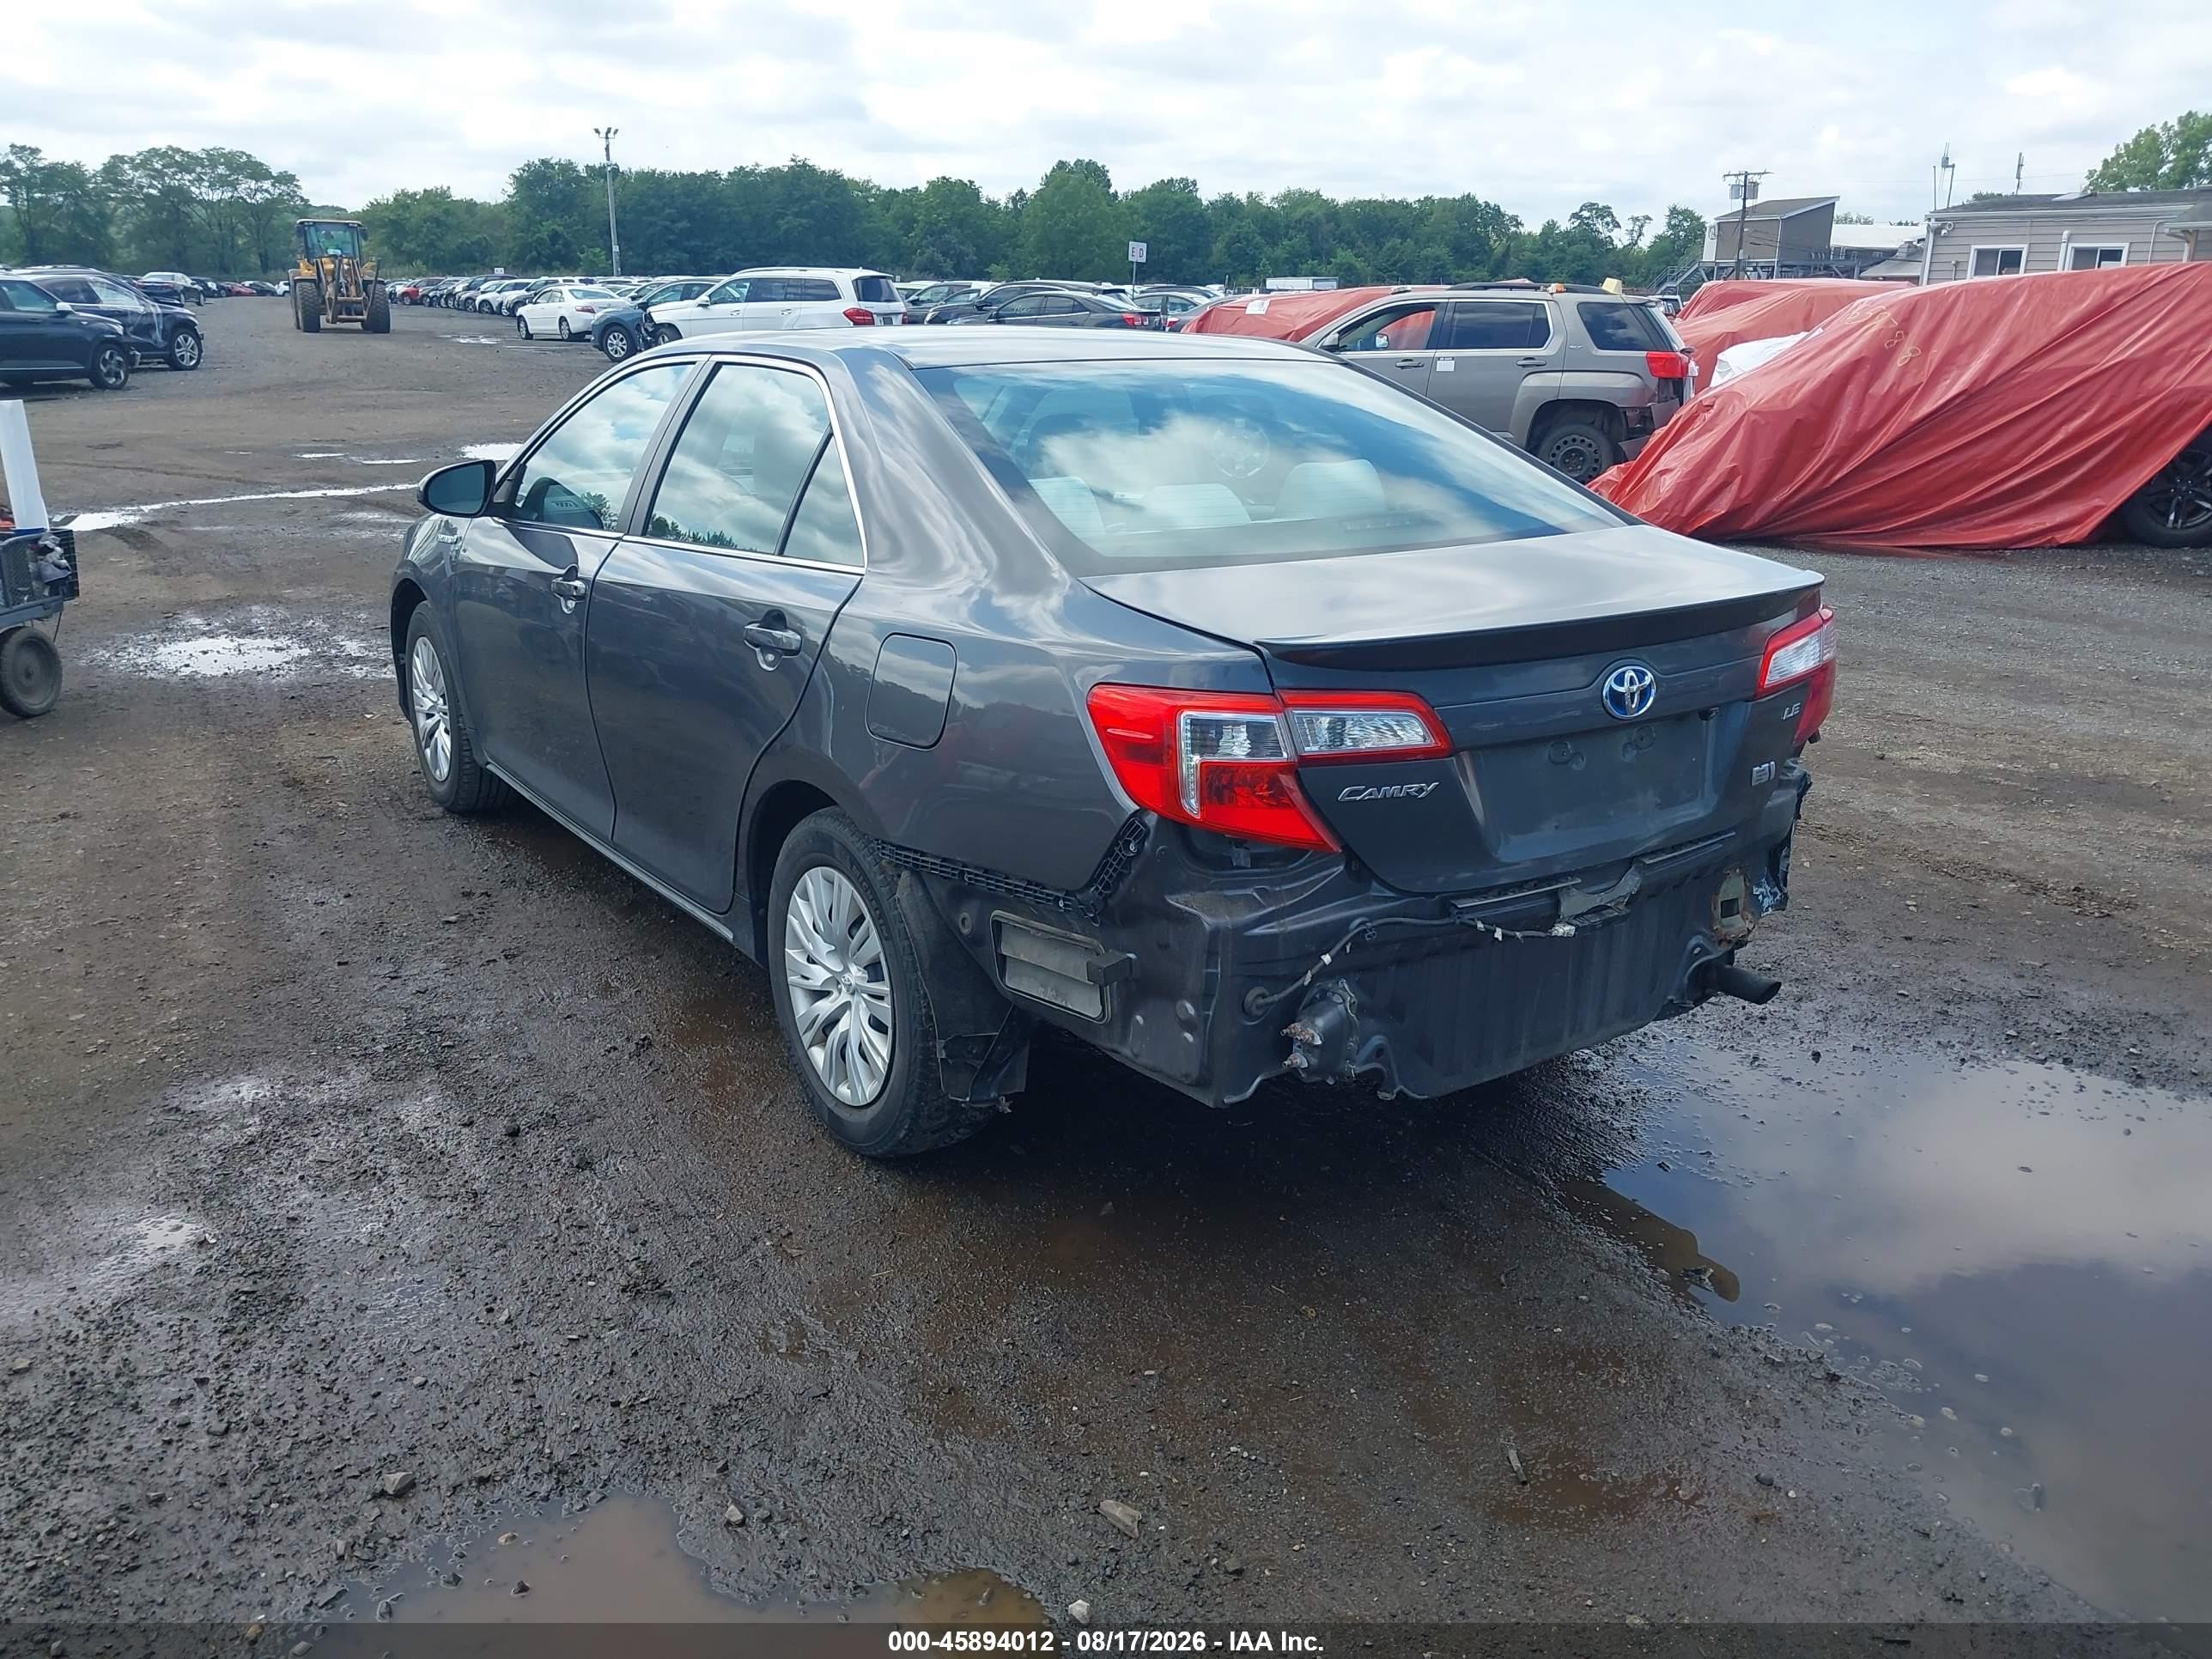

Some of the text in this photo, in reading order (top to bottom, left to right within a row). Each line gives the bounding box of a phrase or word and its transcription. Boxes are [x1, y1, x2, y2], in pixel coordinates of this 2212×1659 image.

[1131, 246, 1144, 258] E D
[1781, 702, 1801, 720] LE
[1338, 781, 1439, 802] CAMRY
